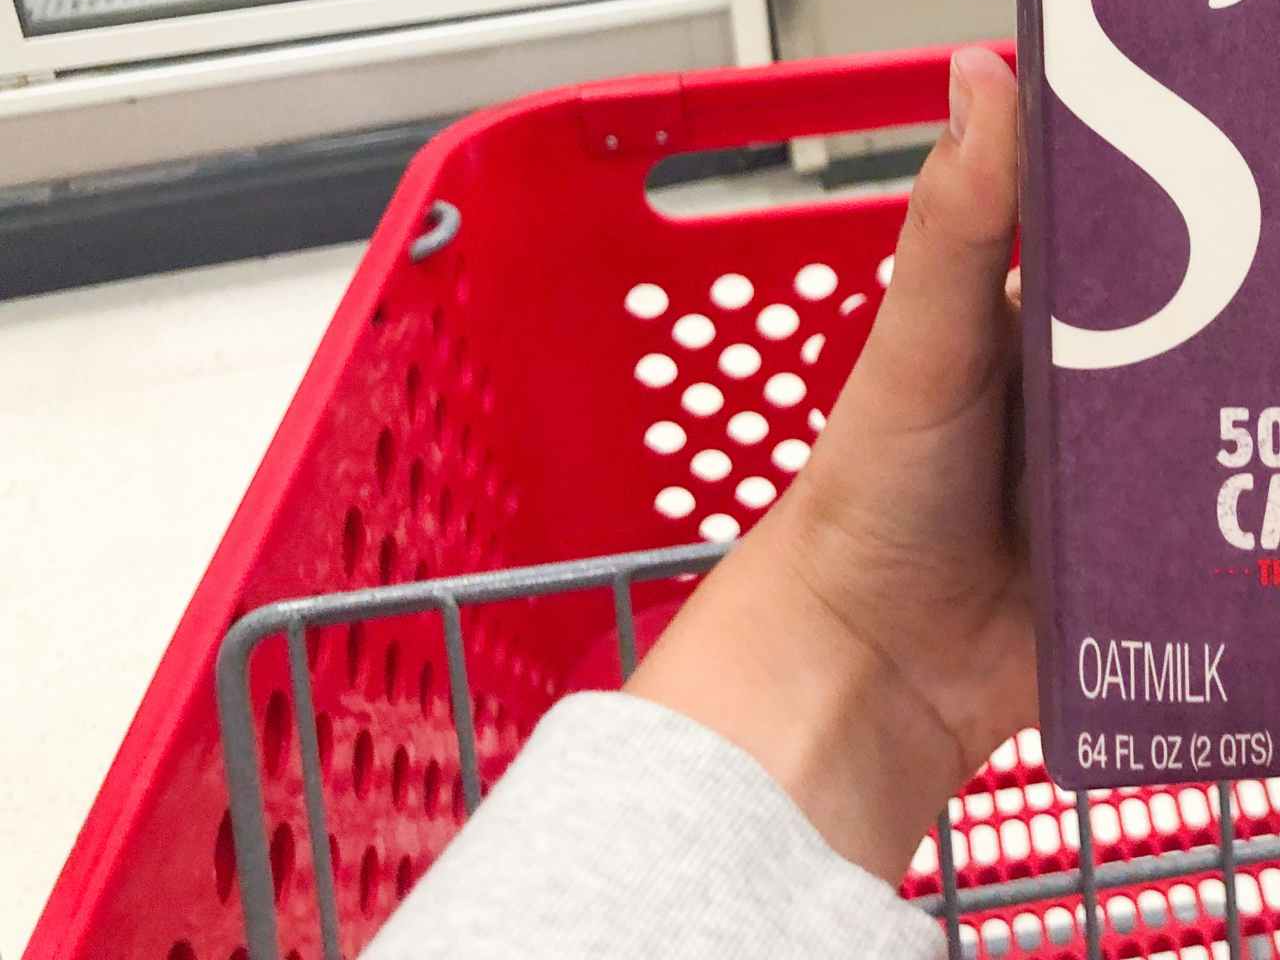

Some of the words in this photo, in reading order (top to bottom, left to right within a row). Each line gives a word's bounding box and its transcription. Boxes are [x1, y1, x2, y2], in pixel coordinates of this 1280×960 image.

[1078, 636, 1229, 703] OATMILK
[1077, 731, 1108, 770] 64
[1115, 734, 1144, 770] FL
[1150, 735, 1183, 770] OZ
[1190, 732, 1212, 772] (2
[1219, 729, 1273, 767] QTS)
